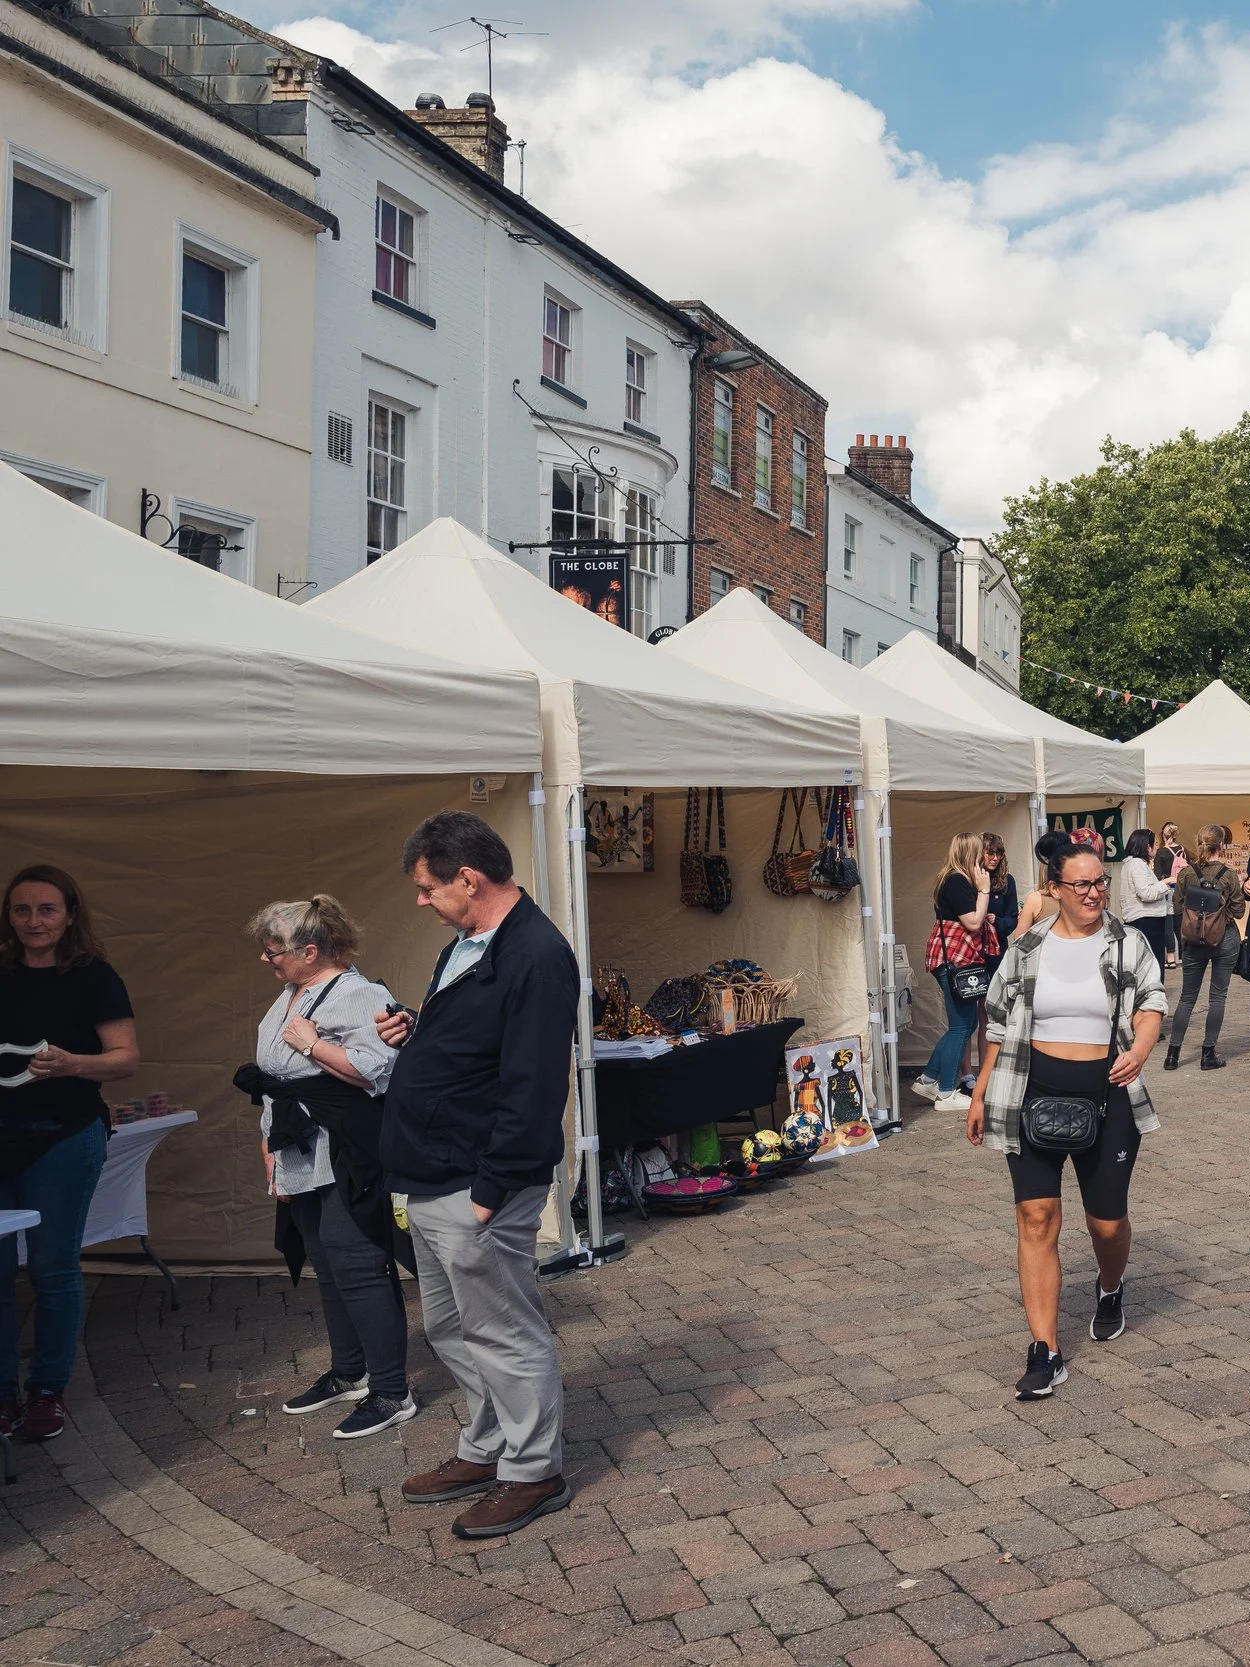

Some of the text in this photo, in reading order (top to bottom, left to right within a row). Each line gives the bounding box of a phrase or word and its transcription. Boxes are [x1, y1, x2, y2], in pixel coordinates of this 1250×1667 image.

[561, 561, 619, 571] THE GLOBE
[655, 627, 676, 638] GLOB
